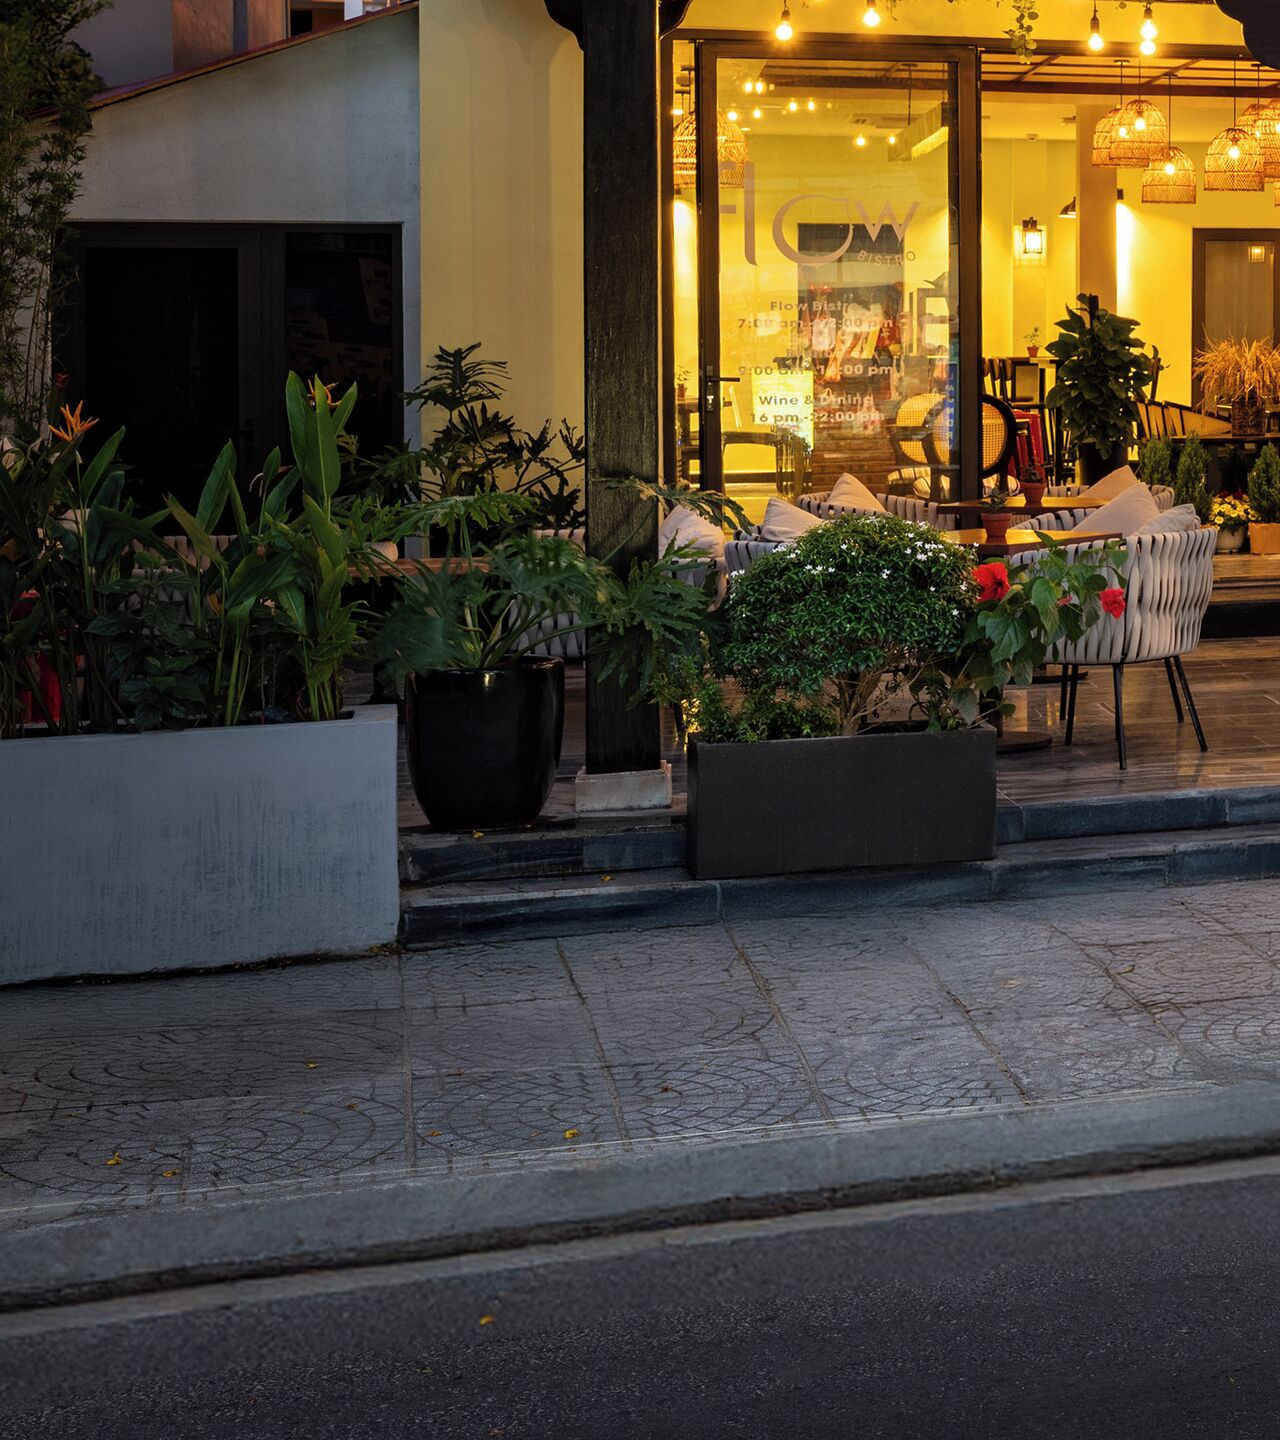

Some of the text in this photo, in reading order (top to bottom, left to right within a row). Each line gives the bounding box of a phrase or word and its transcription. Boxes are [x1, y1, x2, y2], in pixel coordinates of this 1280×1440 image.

[857, 249, 916, 266] BISTRO
[770, 301, 808, 311] Flow
[868, 365, 892, 377] pm
[758, 394, 799, 406] Wine
[749, 413, 769, 423] 16
[773, 414, 800, 425] pm
